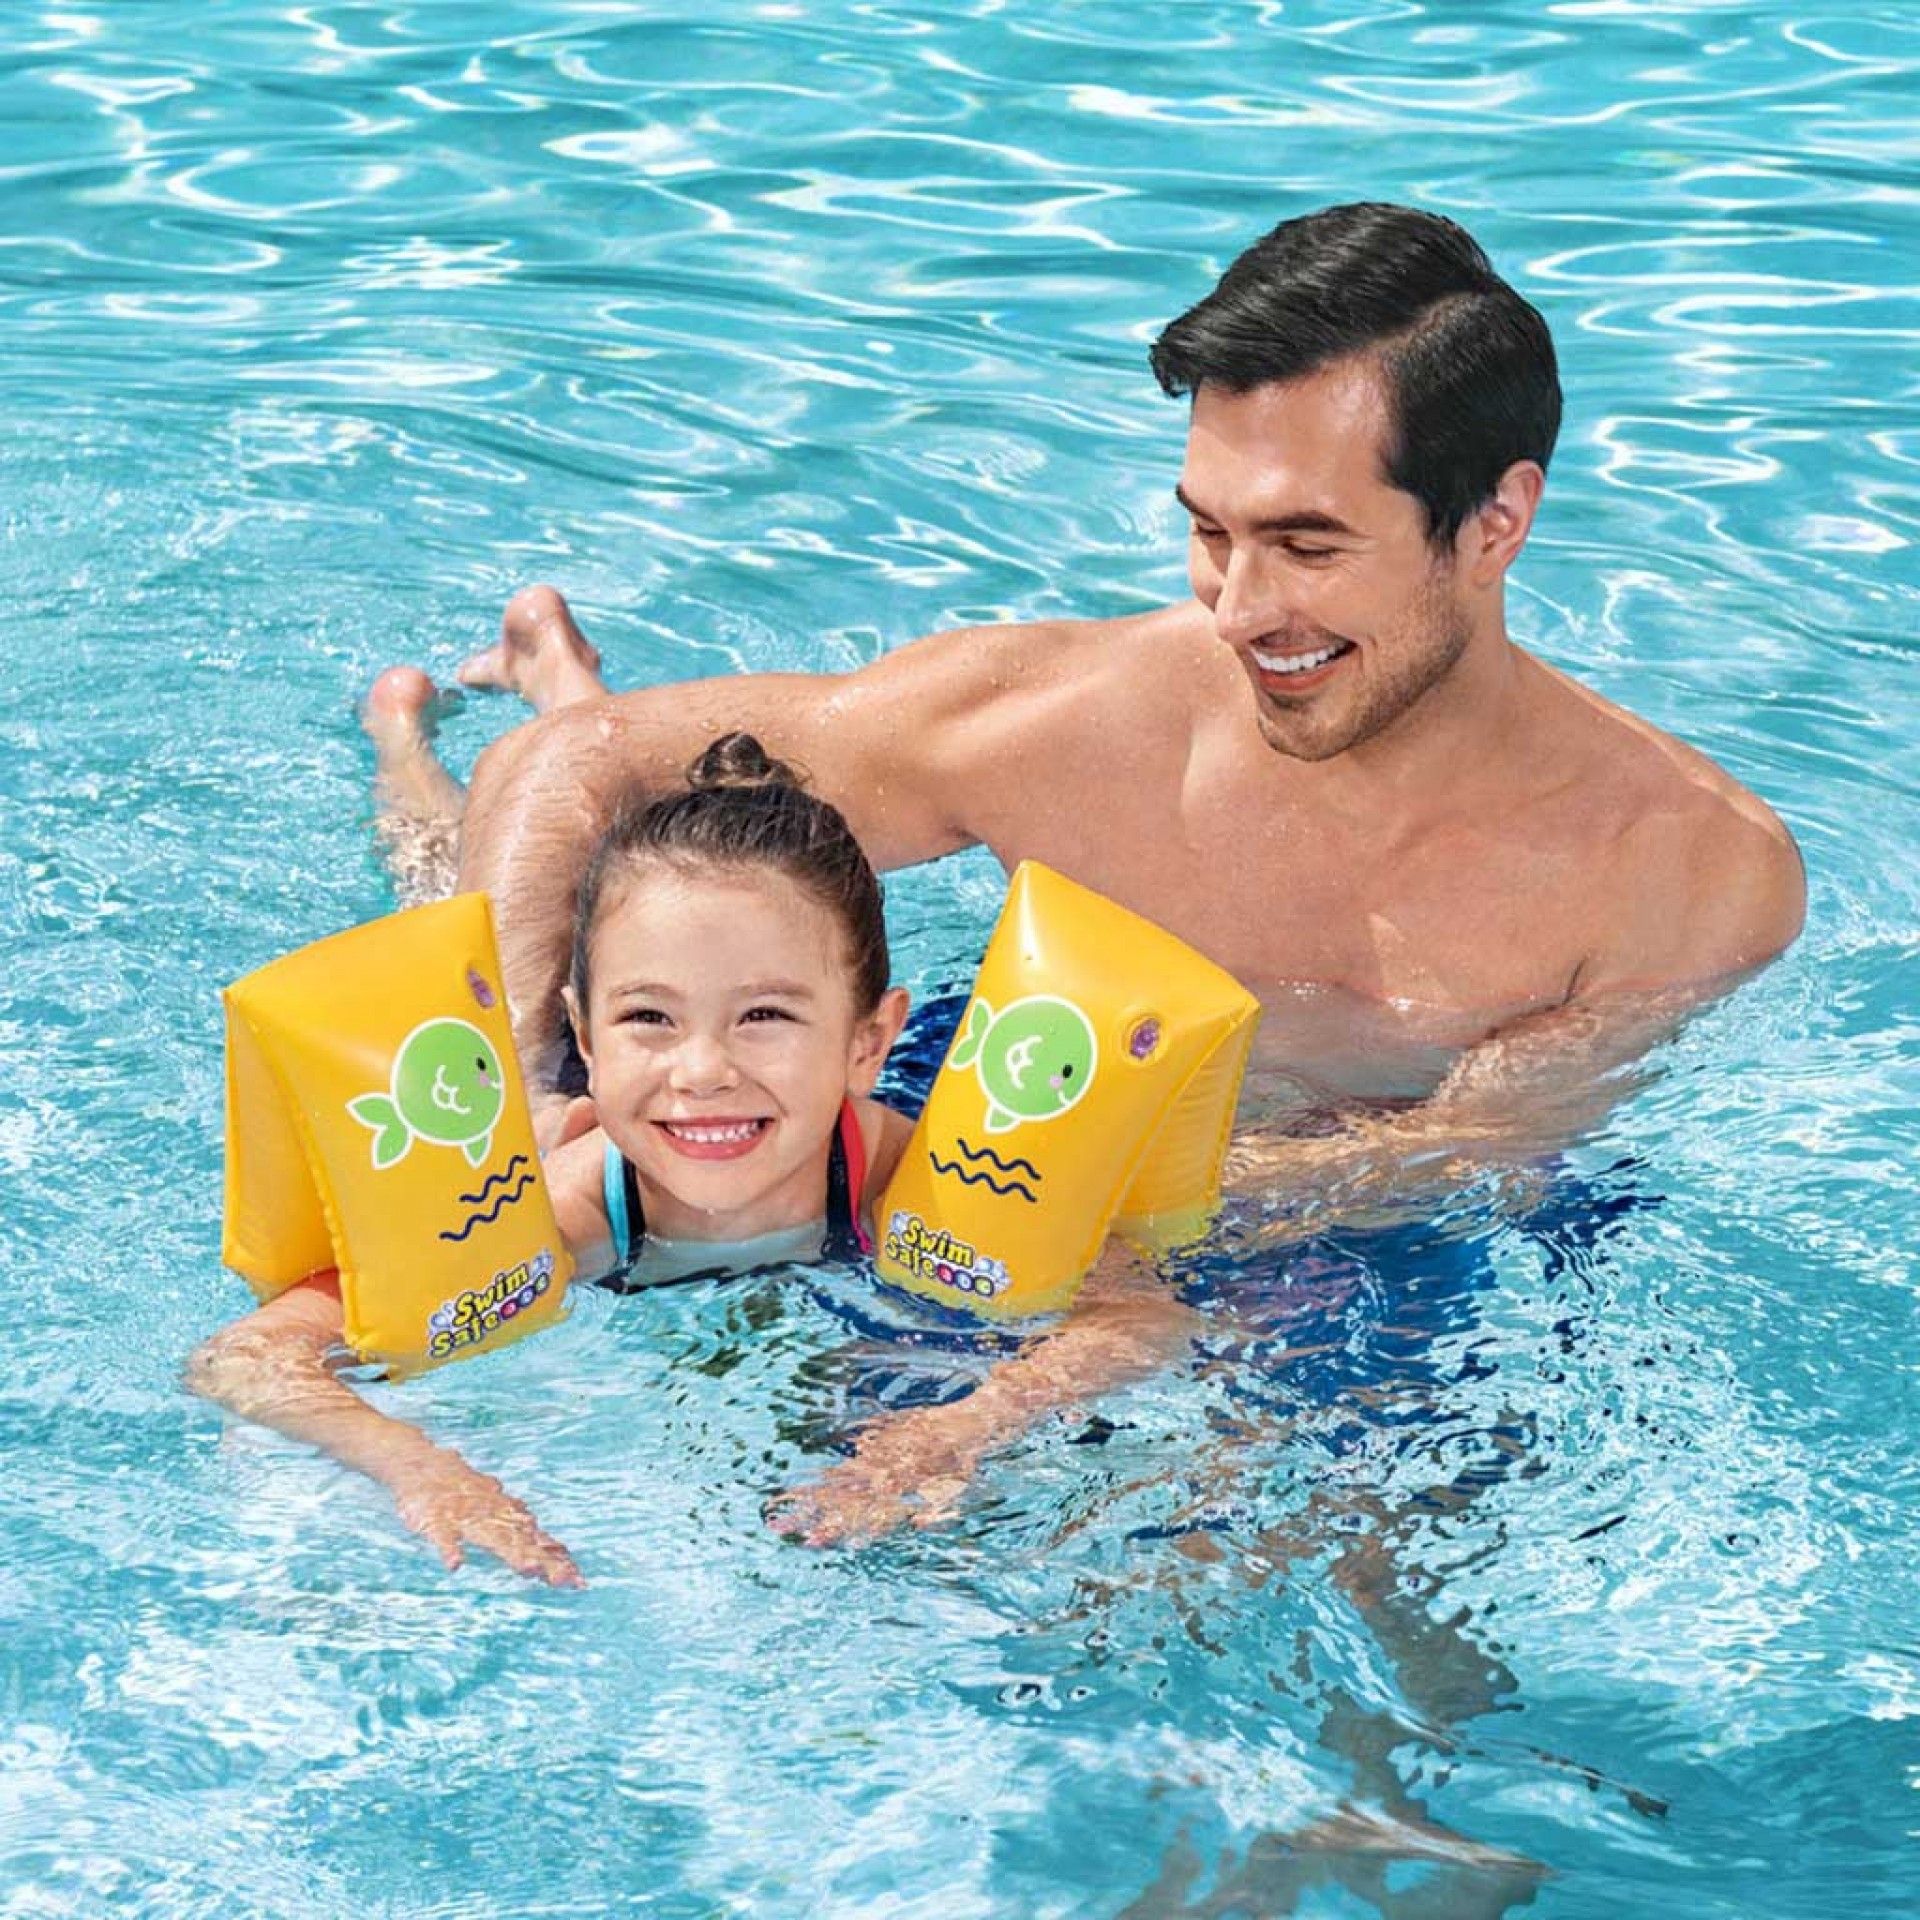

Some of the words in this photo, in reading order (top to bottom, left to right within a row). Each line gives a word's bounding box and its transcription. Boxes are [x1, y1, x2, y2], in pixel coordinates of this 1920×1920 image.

[902, 1217, 974, 1268] Swim
[452, 1263, 529, 1326] Swim
[431, 1312, 500, 1358] Safe
